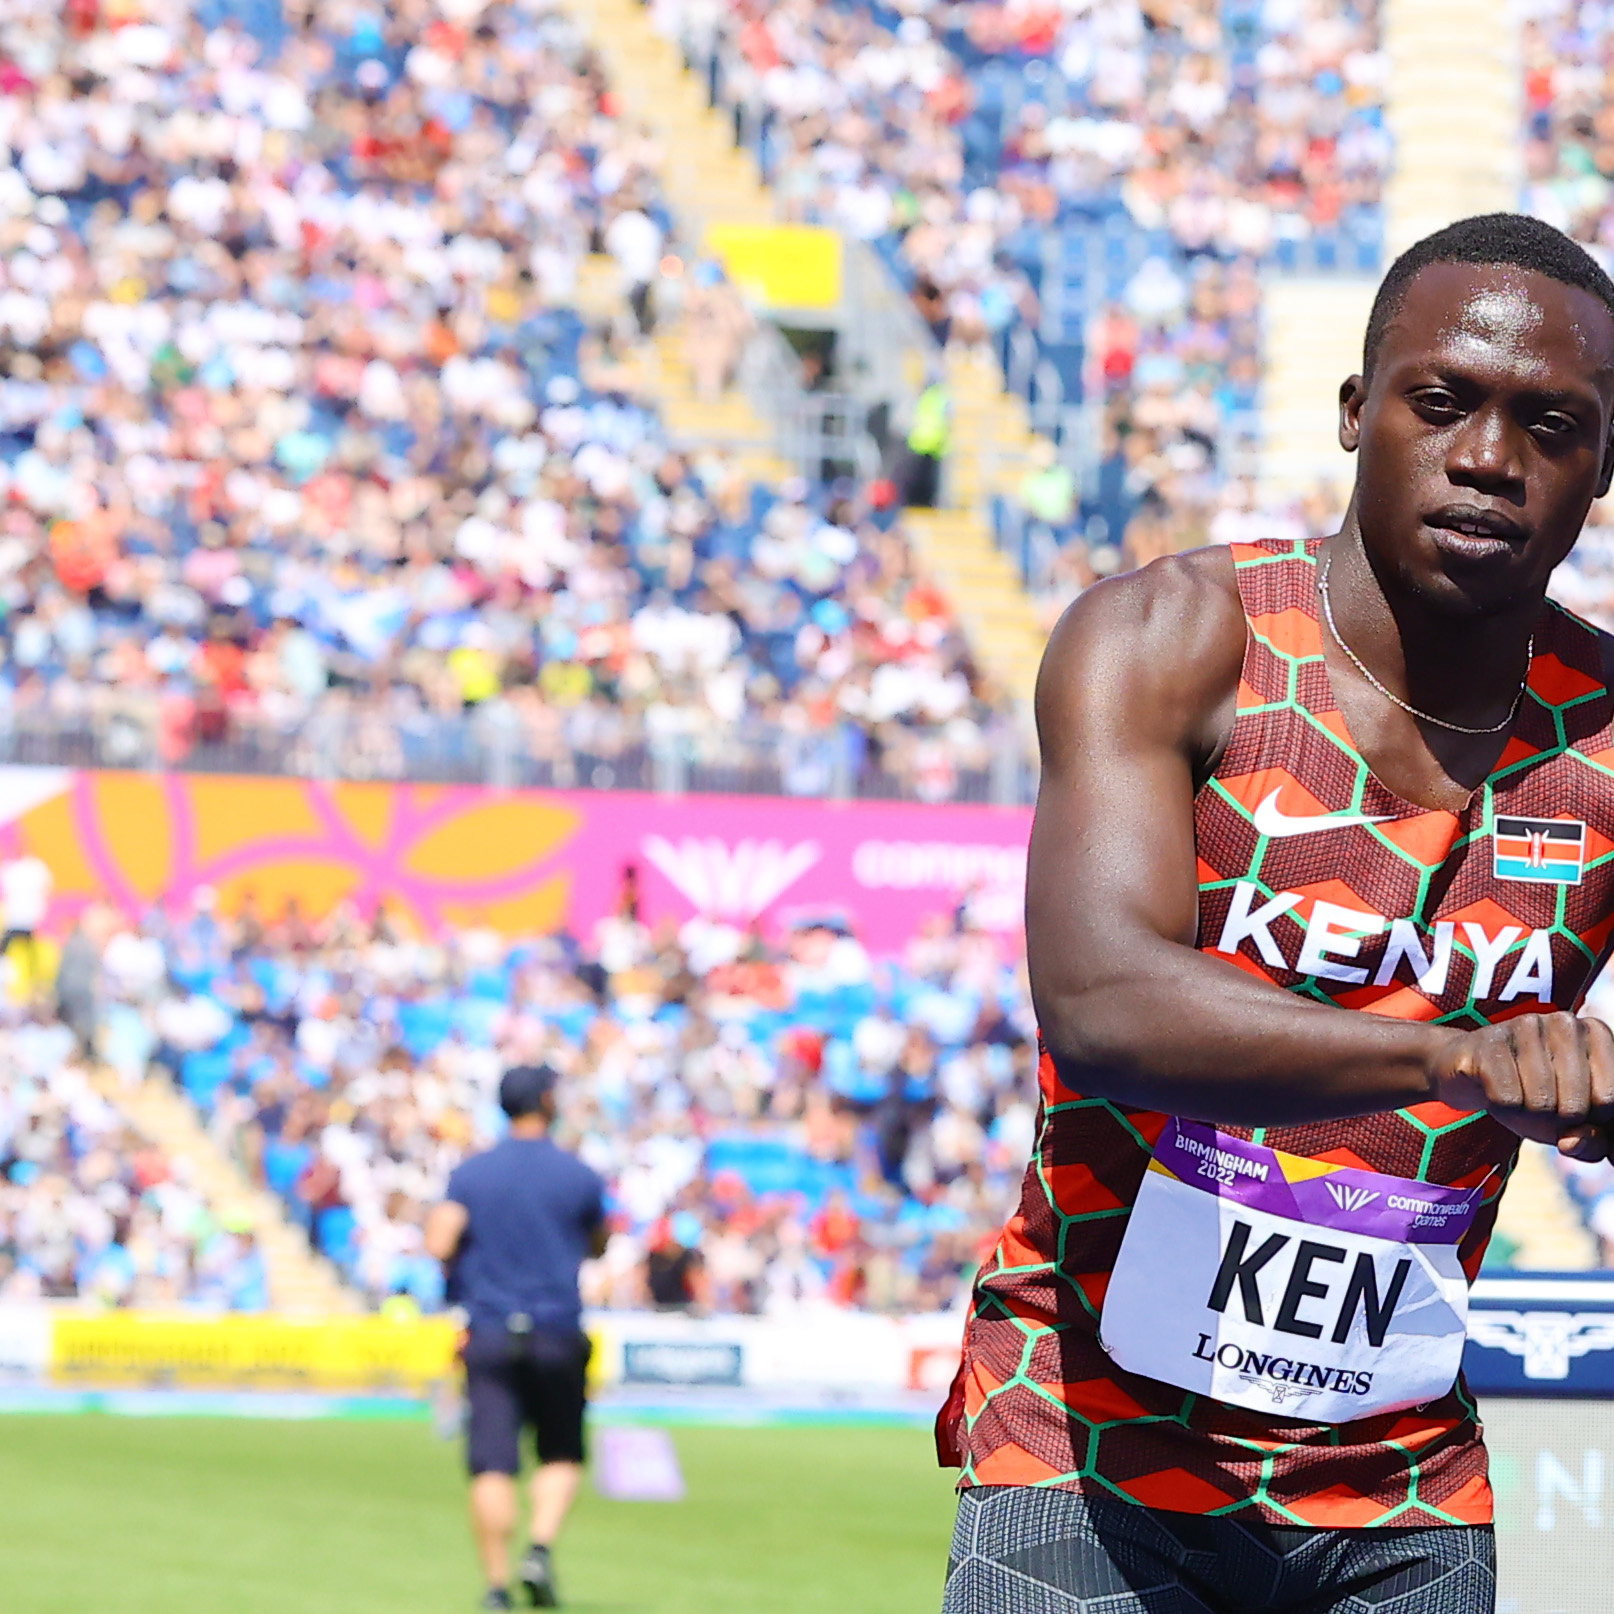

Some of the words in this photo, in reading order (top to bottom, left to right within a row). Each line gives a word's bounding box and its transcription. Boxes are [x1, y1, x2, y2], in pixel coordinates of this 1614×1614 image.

[1217, 880, 1554, 1004] KENYA
[1174, 1134, 1270, 1183] BIRMINGHAM
[1196, 1160, 1236, 1188] 2022
[1413, 1213, 1448, 1228] games
[1206, 1221, 1411, 1348] KEN
[1191, 1332, 1375, 1396] LONGINES
